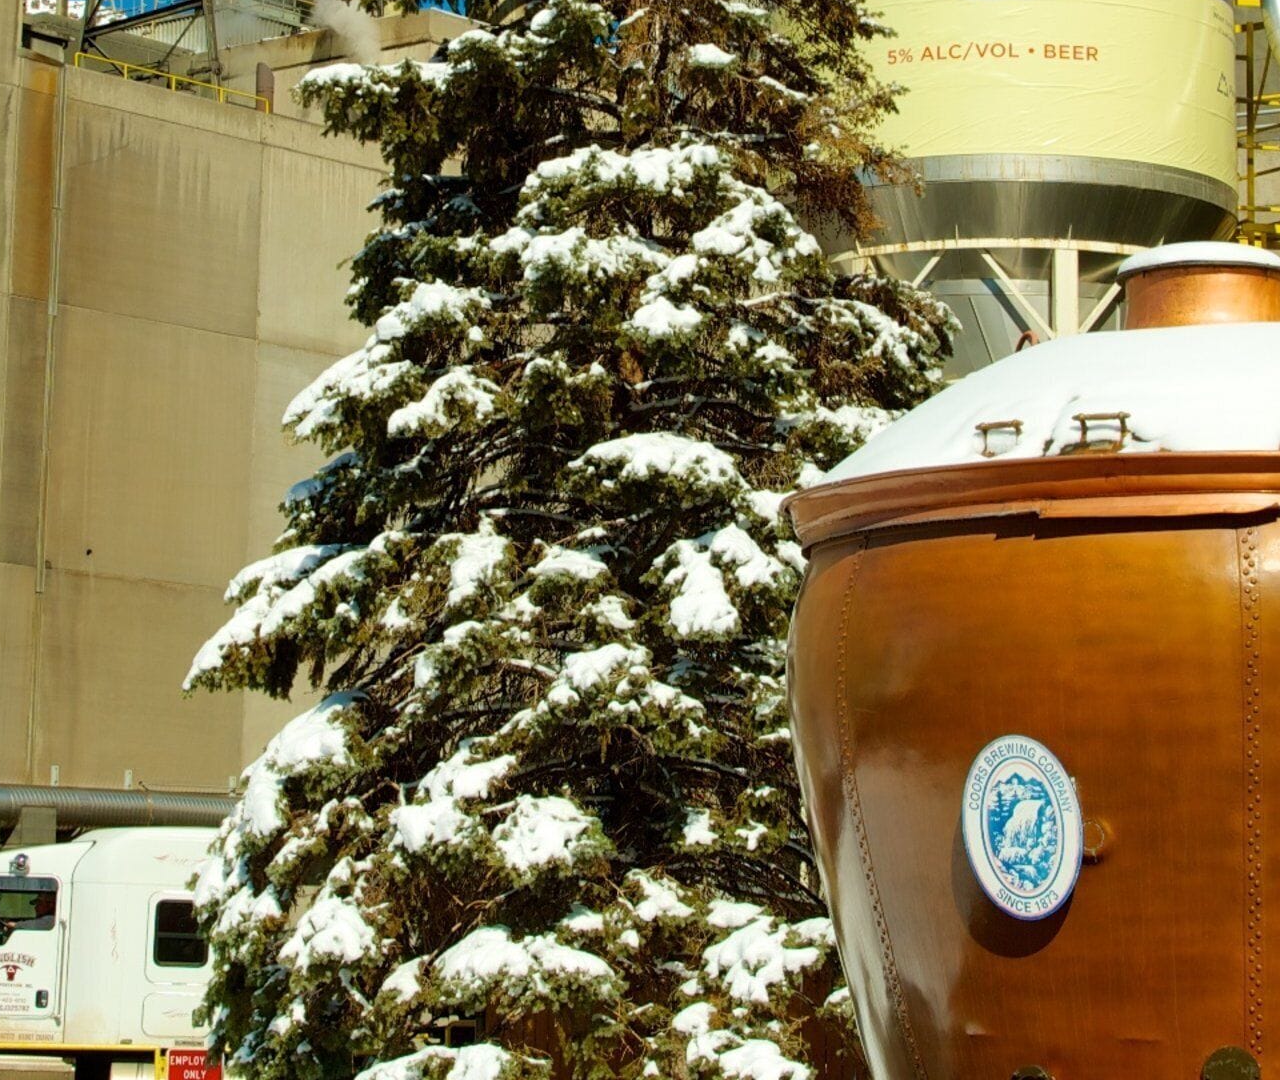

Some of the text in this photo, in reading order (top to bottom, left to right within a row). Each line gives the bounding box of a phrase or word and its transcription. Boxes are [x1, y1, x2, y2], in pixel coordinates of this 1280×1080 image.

[886, 41, 1099, 65] 5% ALC/VOL BEER
[968, 743, 1073, 813] COORS BREWING COMPANY
[996, 889, 1059, 913] SINCE 1873
[170, 1055, 220, 1066] EMPLOY
[183, 1070, 207, 1080] ONLY
